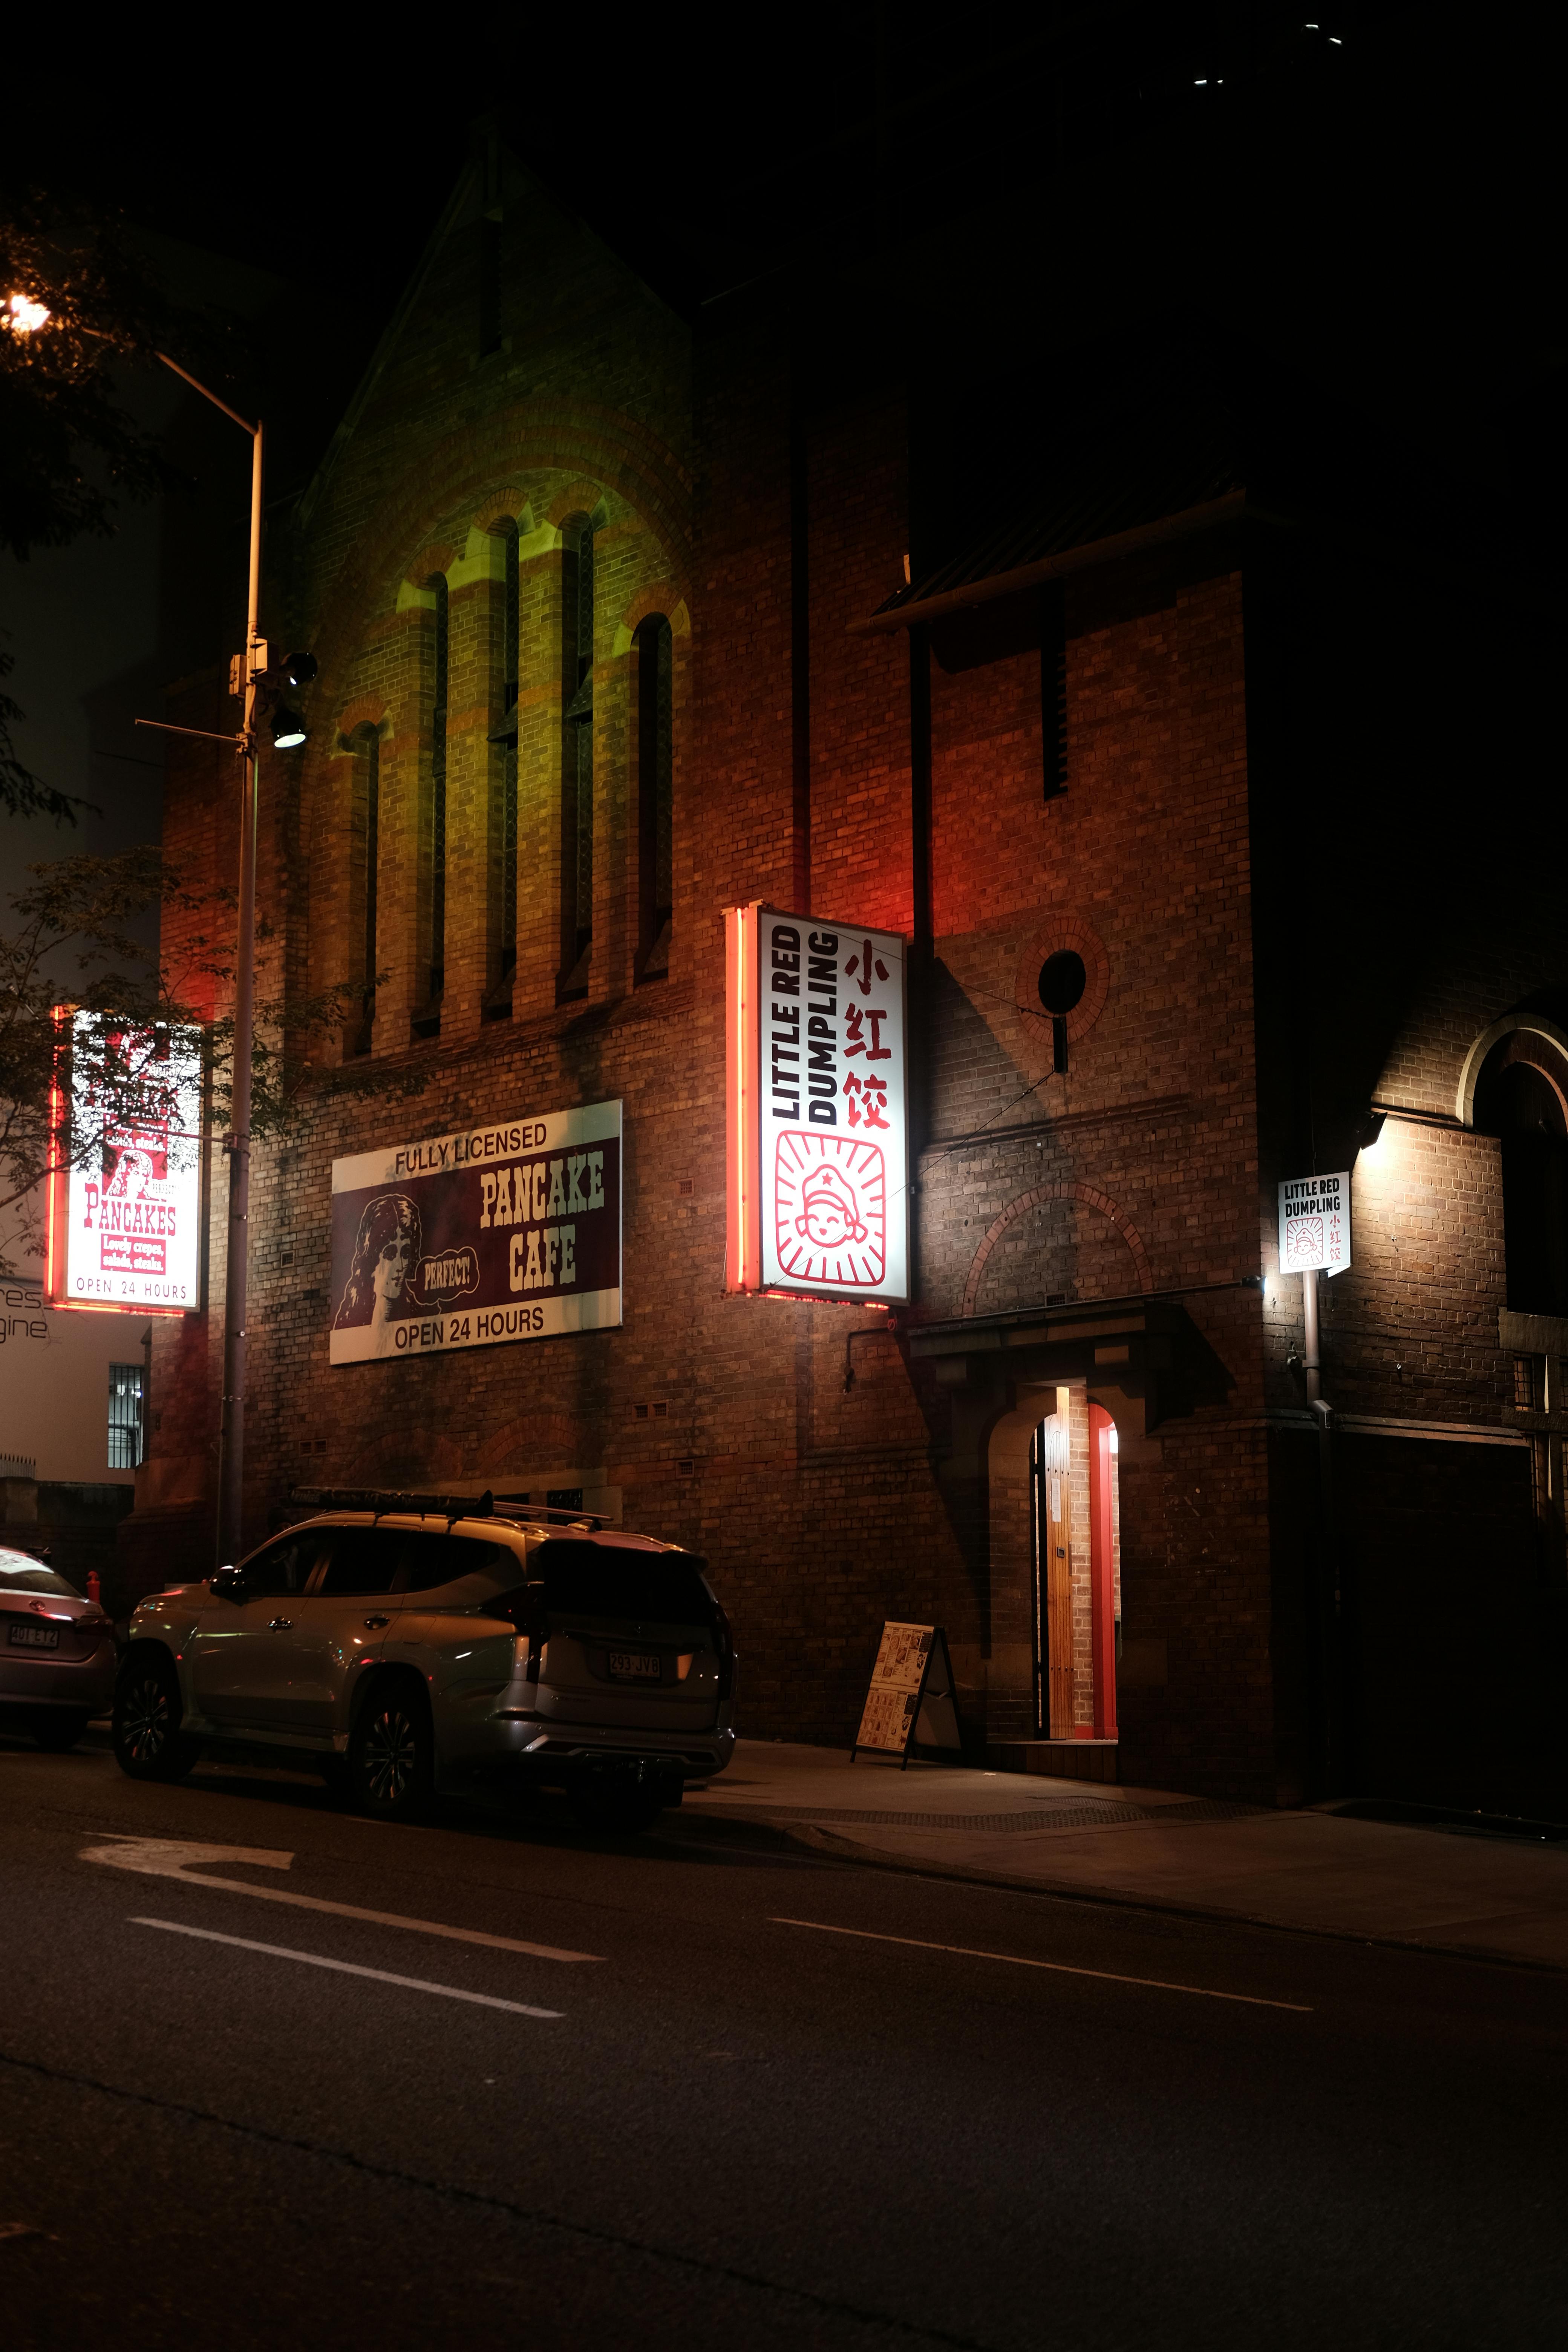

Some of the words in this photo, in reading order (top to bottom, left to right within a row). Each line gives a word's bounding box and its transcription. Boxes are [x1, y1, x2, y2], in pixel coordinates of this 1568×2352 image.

[771, 925, 801, 995] RED
[808, 931, 839, 1125] DUMPLING
[843, 939, 892, 1130] 小红饺
[772, 1001, 800, 1120] LITTLE
[396, 1143, 449, 1174] FULLY
[455, 1123, 547, 1163] LICENSED
[84, 1182, 176, 1237] PANCAKES
[152, 1183, 179, 1195] PERFECT
[480, 1150, 605, 1229] PANCAKE
[1285, 1181, 1317, 1200] LITTLE
[1320, 1178, 1340, 1194] RED
[1285, 1196, 1340, 1218] DUMPLING
[103, 1235, 132, 1254] Lovely
[103, 1252, 133, 1270] salads,
[509, 1224, 576, 1292] CAFE
[1330, 1214, 1341, 1261] 小红饺
[77, 1277, 112, 1293] OPEN
[121, 1281, 135, 1295] 24
[145, 1283, 186, 1299] HOURS
[424, 1256, 471, 1291] PERFECT!
[395, 1321, 444, 1349] OPEN
[450, 1318, 471, 1342] 24
[478, 1307, 544, 1339] HOURS
